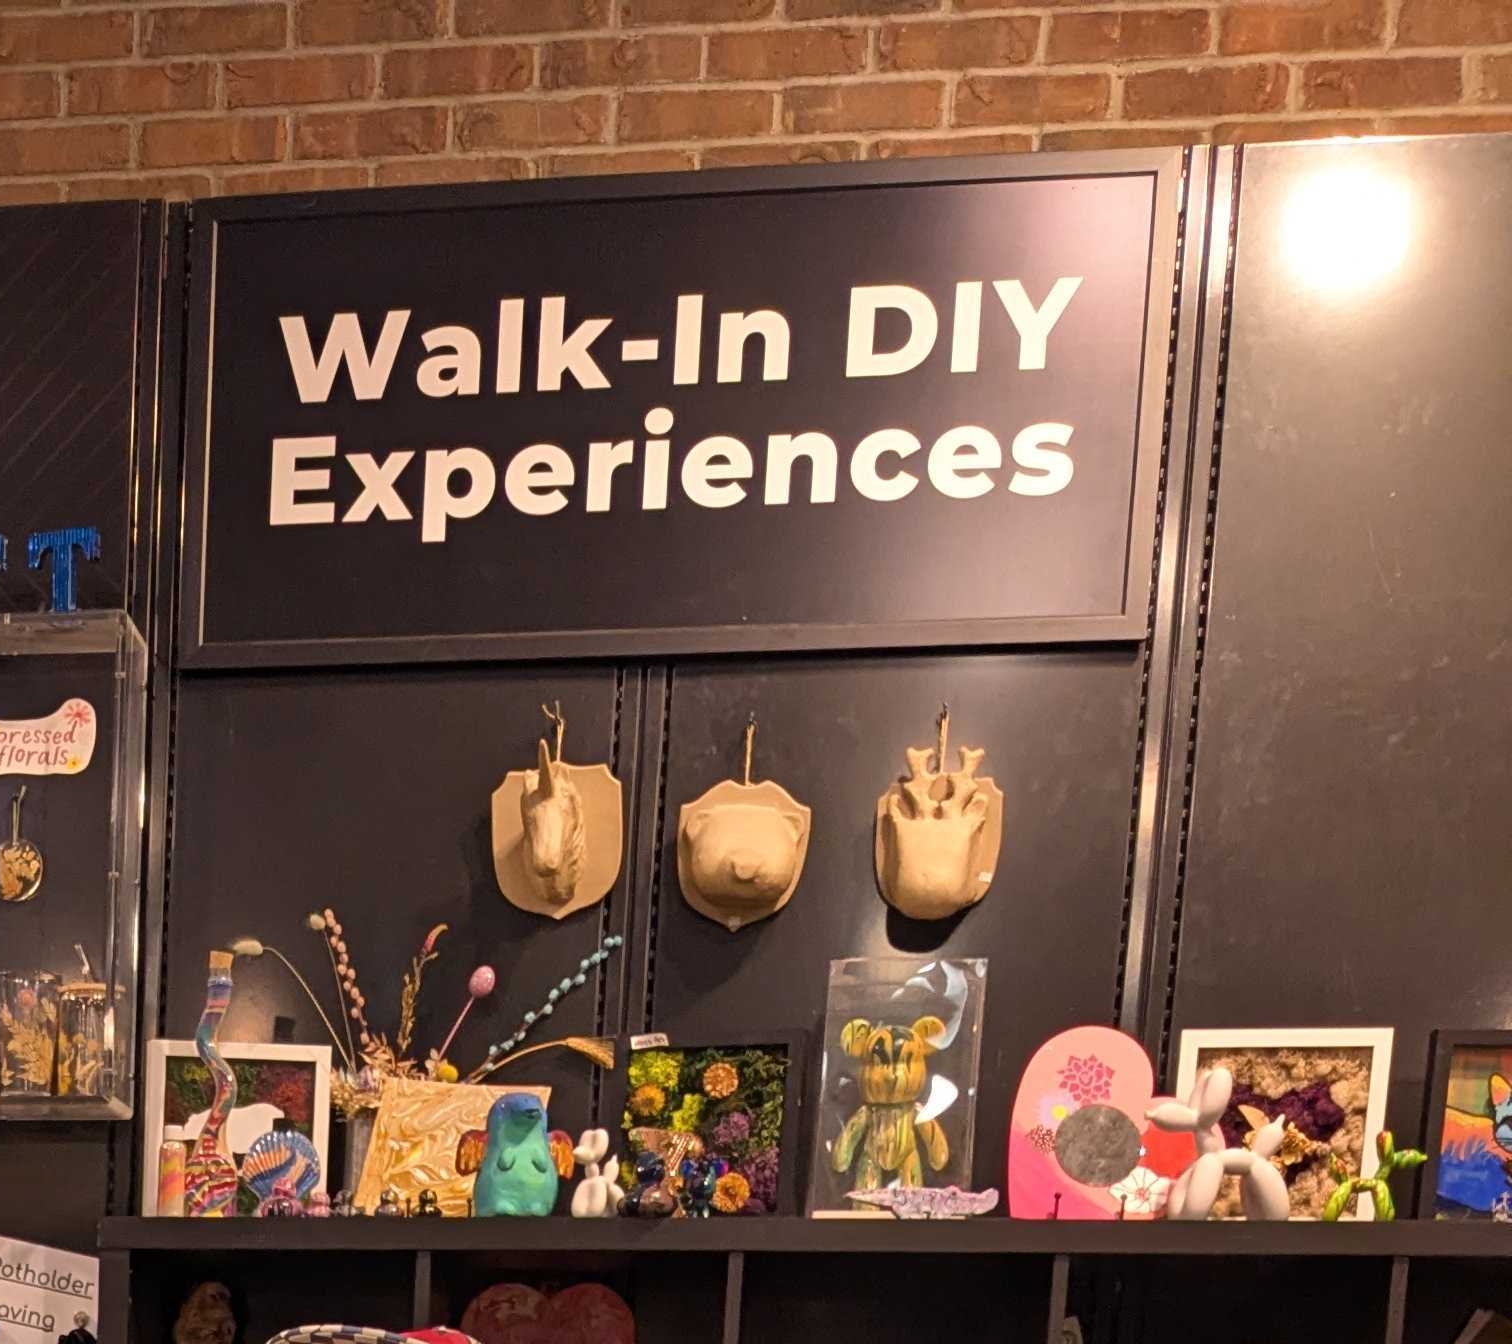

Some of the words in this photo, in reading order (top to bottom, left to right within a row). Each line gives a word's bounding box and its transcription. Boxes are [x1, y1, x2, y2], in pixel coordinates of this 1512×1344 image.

[278, 294, 790, 404] Walk-In
[844, 276, 1084, 378] DIY
[269, 407, 1076, 543] Experiences
